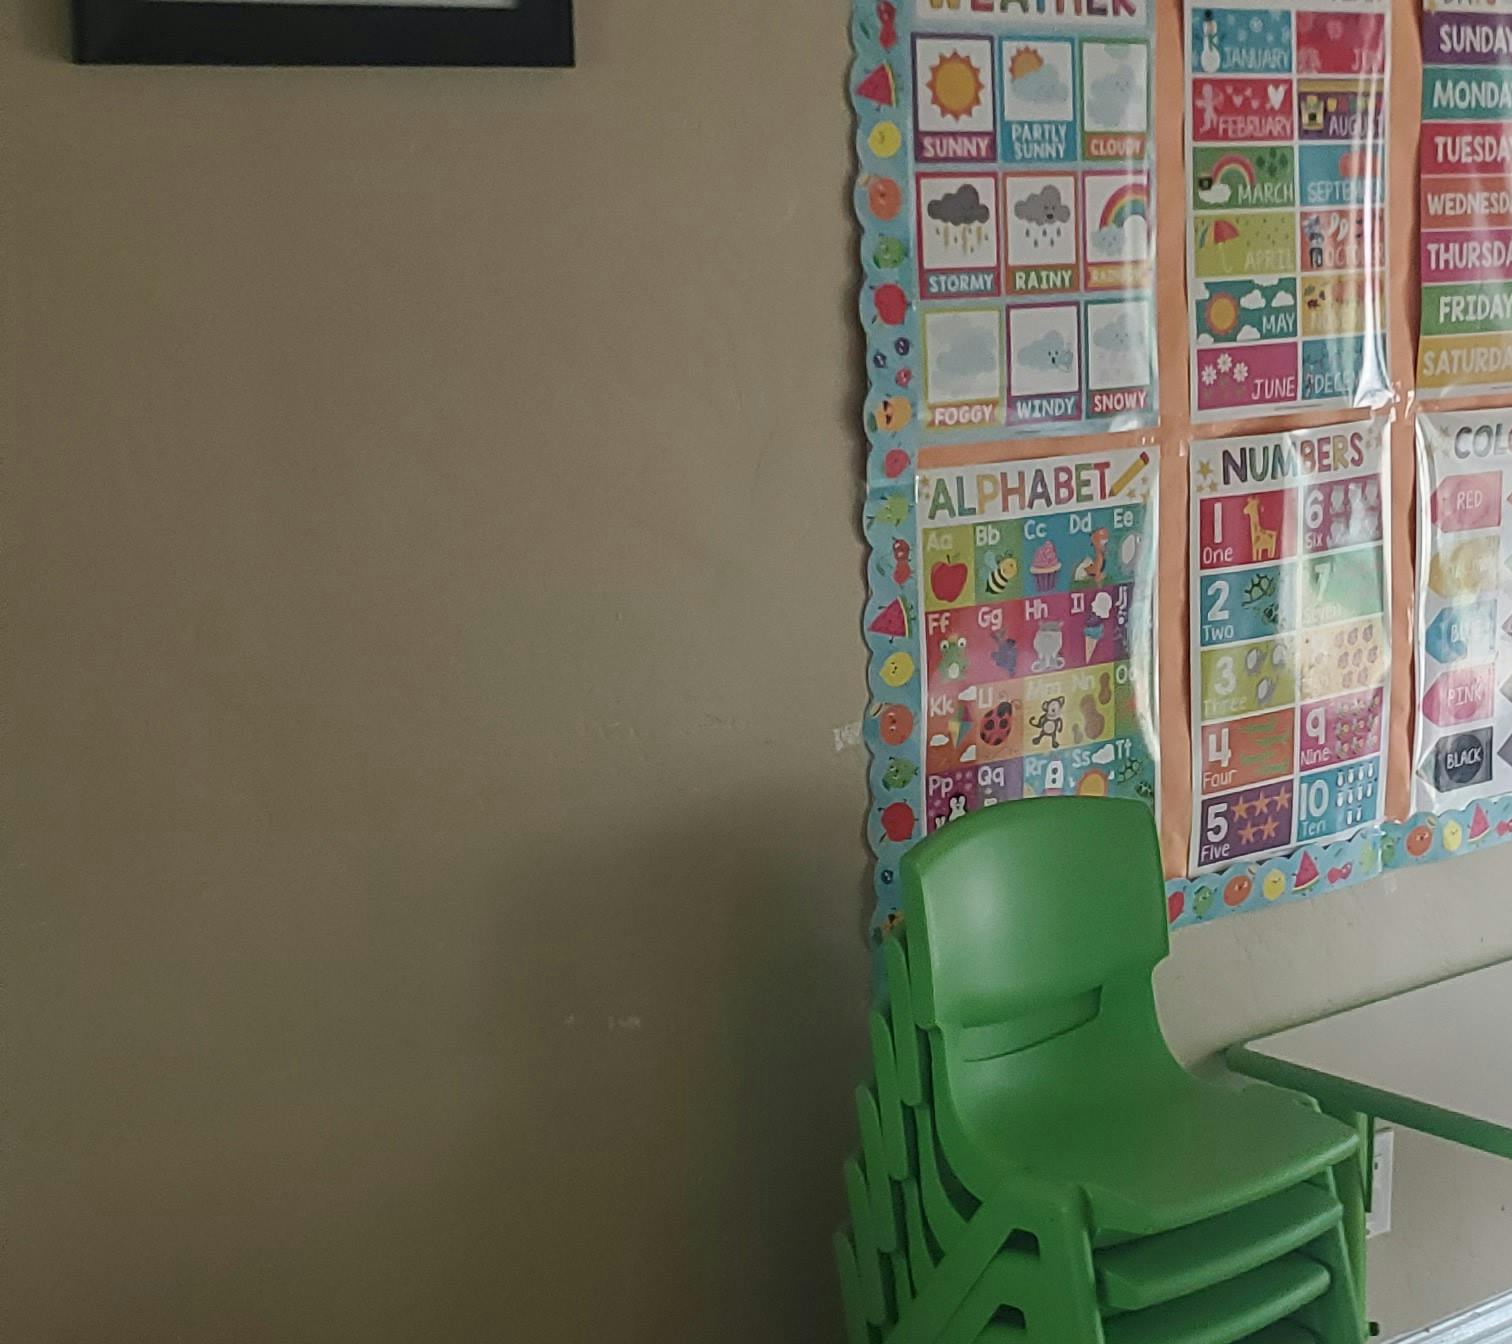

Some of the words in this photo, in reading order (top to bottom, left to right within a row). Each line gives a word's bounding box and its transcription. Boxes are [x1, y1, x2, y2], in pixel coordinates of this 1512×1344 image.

[1222, 46, 1289, 69] JANUARY
[1011, 123, 1067, 143] PARTLY
[1219, 116, 1291, 137] FEBRUARY
[1329, 113, 1384, 137] AUGUT
[922, 136, 991, 158] SUNNY
[1014, 141, 1066, 161] SUNNY
[1238, 183, 1294, 202] MARCH
[1244, 248, 1294, 270] APRIL
[928, 273, 994, 293] STORMY
[1015, 270, 1073, 290] RAINY
[1263, 312, 1296, 333] MAY
[1252, 378, 1296, 400] JUNE
[1017, 397, 1075, 419] WINDY
[1094, 391, 1147, 413] SNOWY
[935, 404, 993, 426] FOGGY
[1222, 431, 1364, 485] NUMBERS
[928, 461, 1111, 520] ALPHABET
[1457, 490, 1483, 510] RED
[1306, 490, 1323, 529] 6
[927, 531, 953, 551] Aa
[975, 525, 1000, 546] Bb
[1024, 519, 1048, 540] Cc
[1069, 512, 1092, 534] Dd
[1113, 508, 1134, 528] Ee
[1213, 501, 1222, 544] 1
[1305, 532, 1323, 549] Six
[1202, 546, 1234, 564] One
[1314, 562, 1331, 602] 7
[928, 613, 951, 635] Ff
[978, 607, 1003, 630] Gg
[1025, 599, 1049, 621] Hh
[1116, 586, 1128, 608] Jj
[1207, 580, 1230, 621] 2
[1202, 624, 1235, 641] Two
[1214, 656, 1236, 695] 3
[930, 695, 954, 718] Kk
[1072, 673, 1094, 691] Nn
[1448, 680, 1482, 705] PINK
[1203, 698, 1248, 717] Three
[1306, 707, 1326, 745] 9
[1209, 728, 1231, 767] 4
[1300, 746, 1330, 766] Nine
[1447, 747, 1482, 769] BLACK
[928, 776, 953, 798] Pp
[977, 766, 1005, 787] Qq
[1024, 758, 1046, 777] Rr
[1072, 749, 1091, 768] Ss
[1115, 738, 1132, 758] Tt
[1203, 769, 1237, 789] Four
[1300, 779, 1329, 821] 10
[1207, 802, 1228, 843] 5
[1302, 821, 1326, 836] Ten
[1200, 843, 1231, 863] Five
